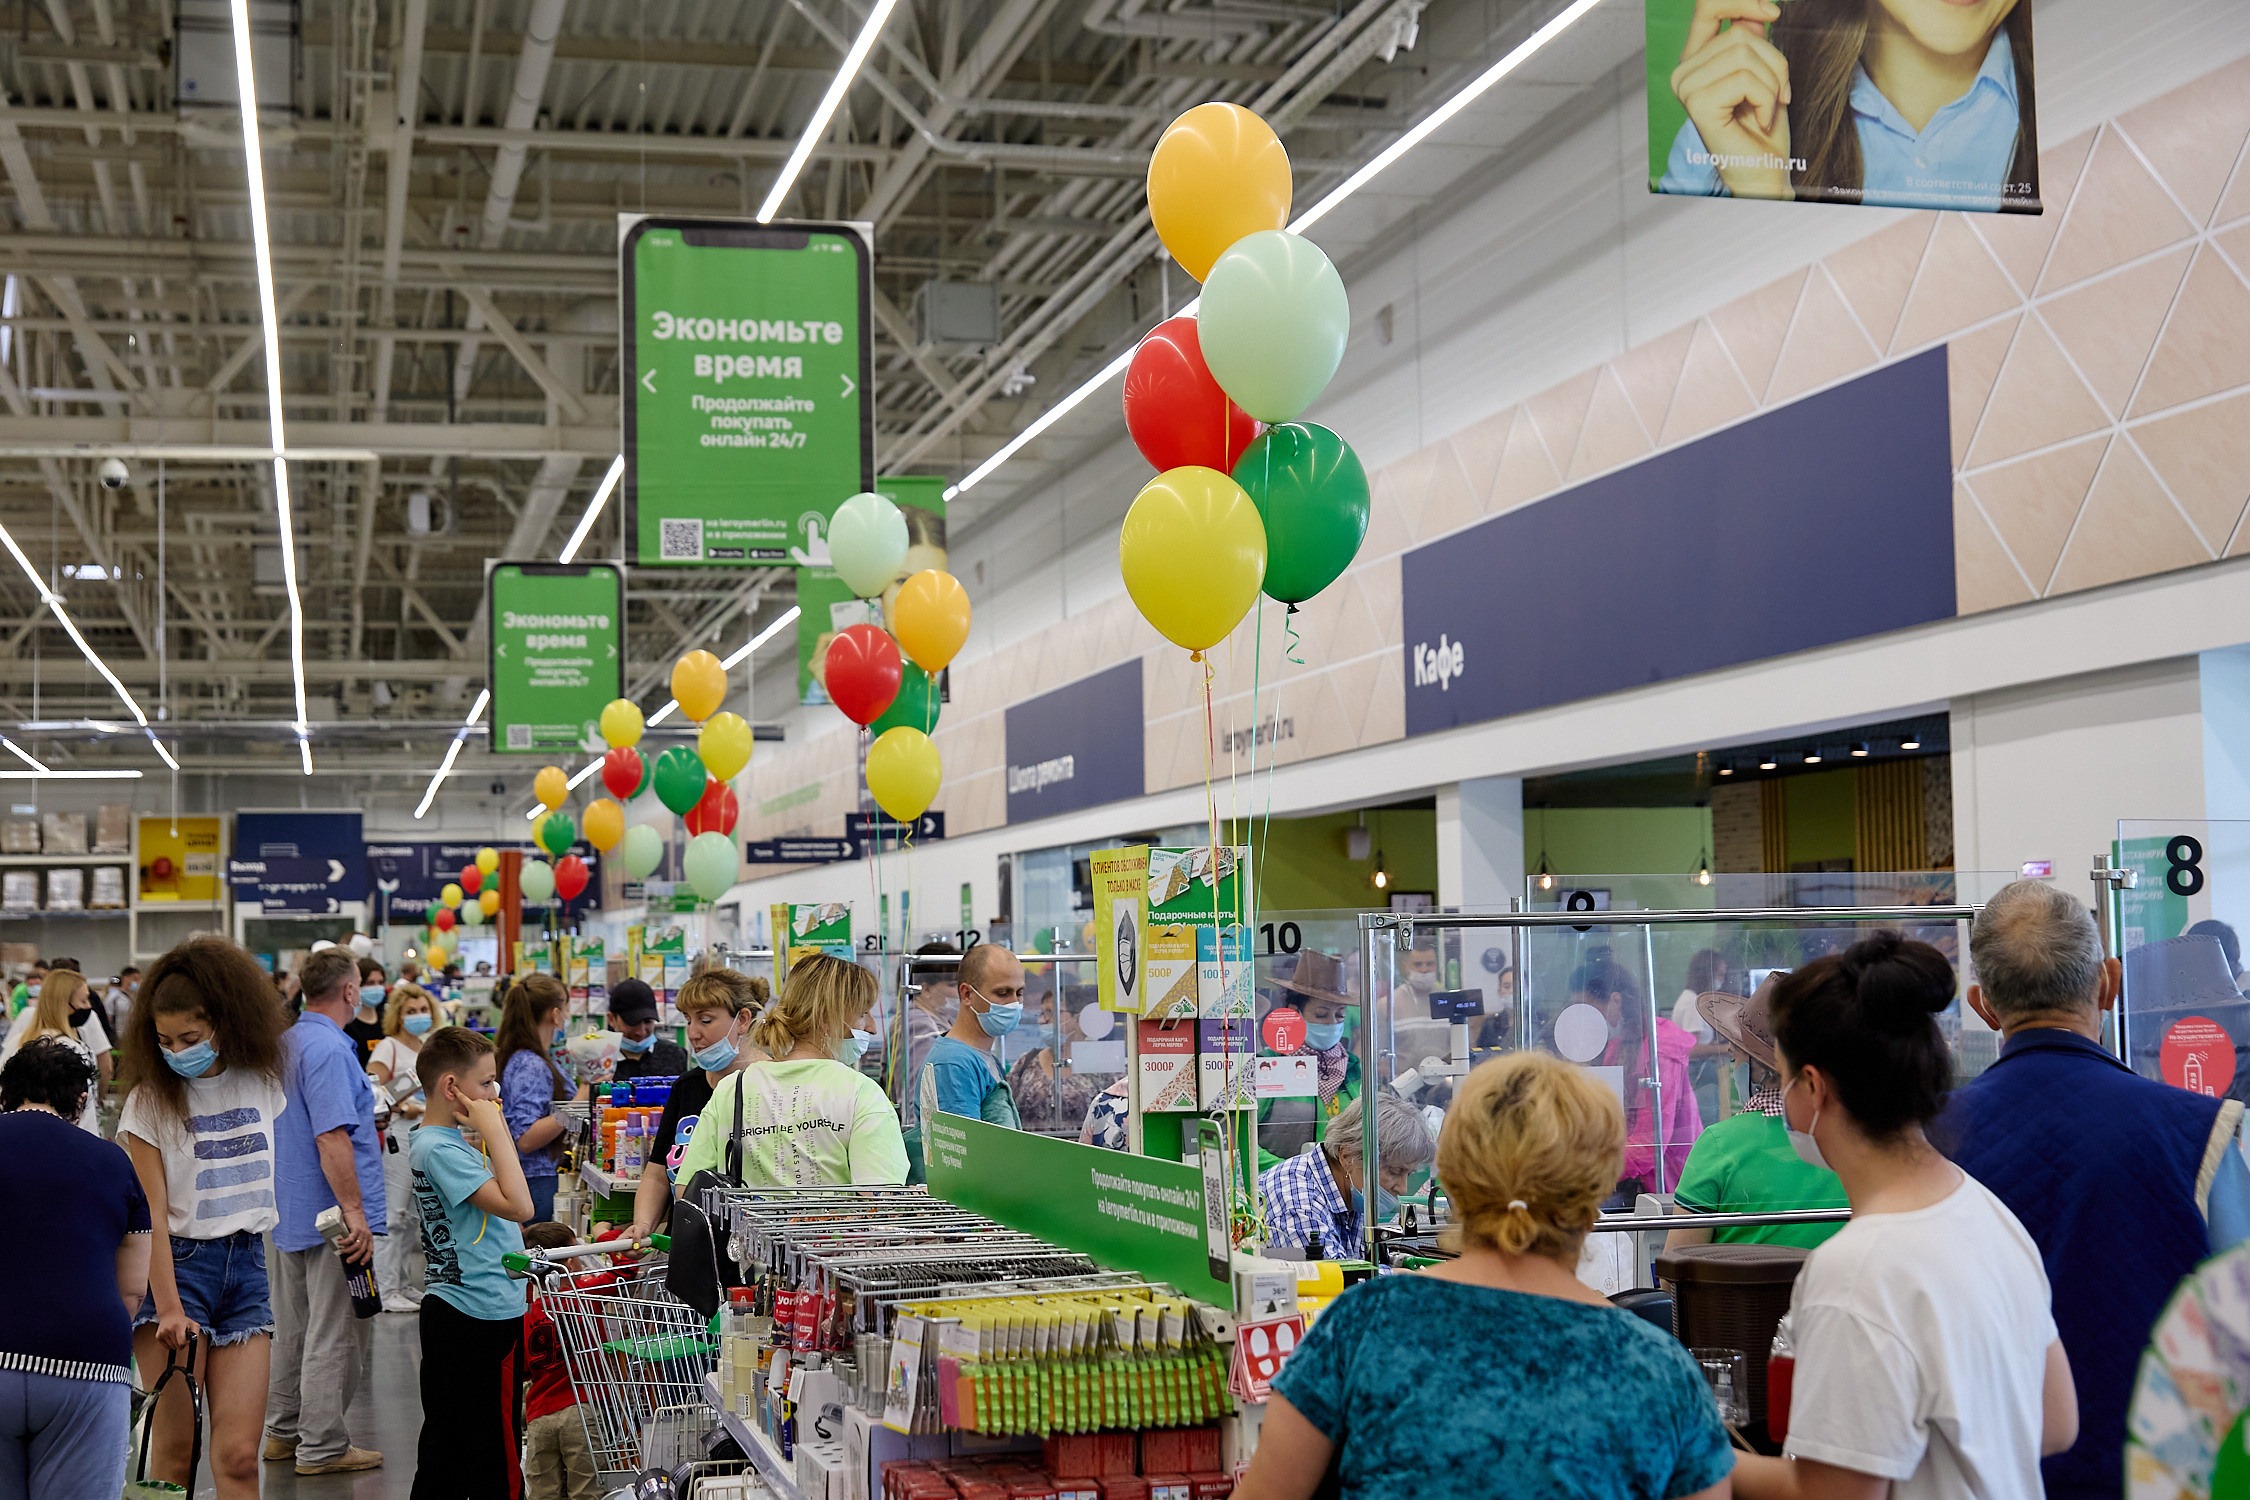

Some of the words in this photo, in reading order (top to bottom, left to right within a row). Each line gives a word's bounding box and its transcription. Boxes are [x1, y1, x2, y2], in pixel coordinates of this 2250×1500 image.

[1686, 147, 1807, 172] leroymerlin.ru
[2018, 183, 2032, 195] 25
[651, 311, 844, 345] Экономьте
[694, 353, 803, 383] время
[691, 394, 815, 413] Продолжайте
[711, 414, 793, 434] покупать
[700, 431, 766, 448] онлайн
[768, 433, 807, 449] 24/7
[502, 611, 610, 630] Экономьте
[526, 633, 588, 652] время
[1413, 633, 1465, 692] Кафе
[1092, 860, 1120, 875] КЛИЕНТОВ
[2166, 834, 2204, 897] 8
[1107, 879, 1125, 893] ТОЛЬКО
[1129, 877, 1142, 892] МАСКЕ
[1148, 911, 1207, 922] Подарочные
[955, 929, 981, 951] 12
[1260, 921, 1302, 955] 10
[1148, 967, 1172, 978] 500₽
[1145, 1061, 1174, 1072] 3000₽
[1091, 1167, 1132, 1194] Продолжайте
[1131, 1180, 1161, 1201] покупать
[1160, 1185, 1186, 1207] онлайн
[1156, 1214, 1199, 1240] приложении
